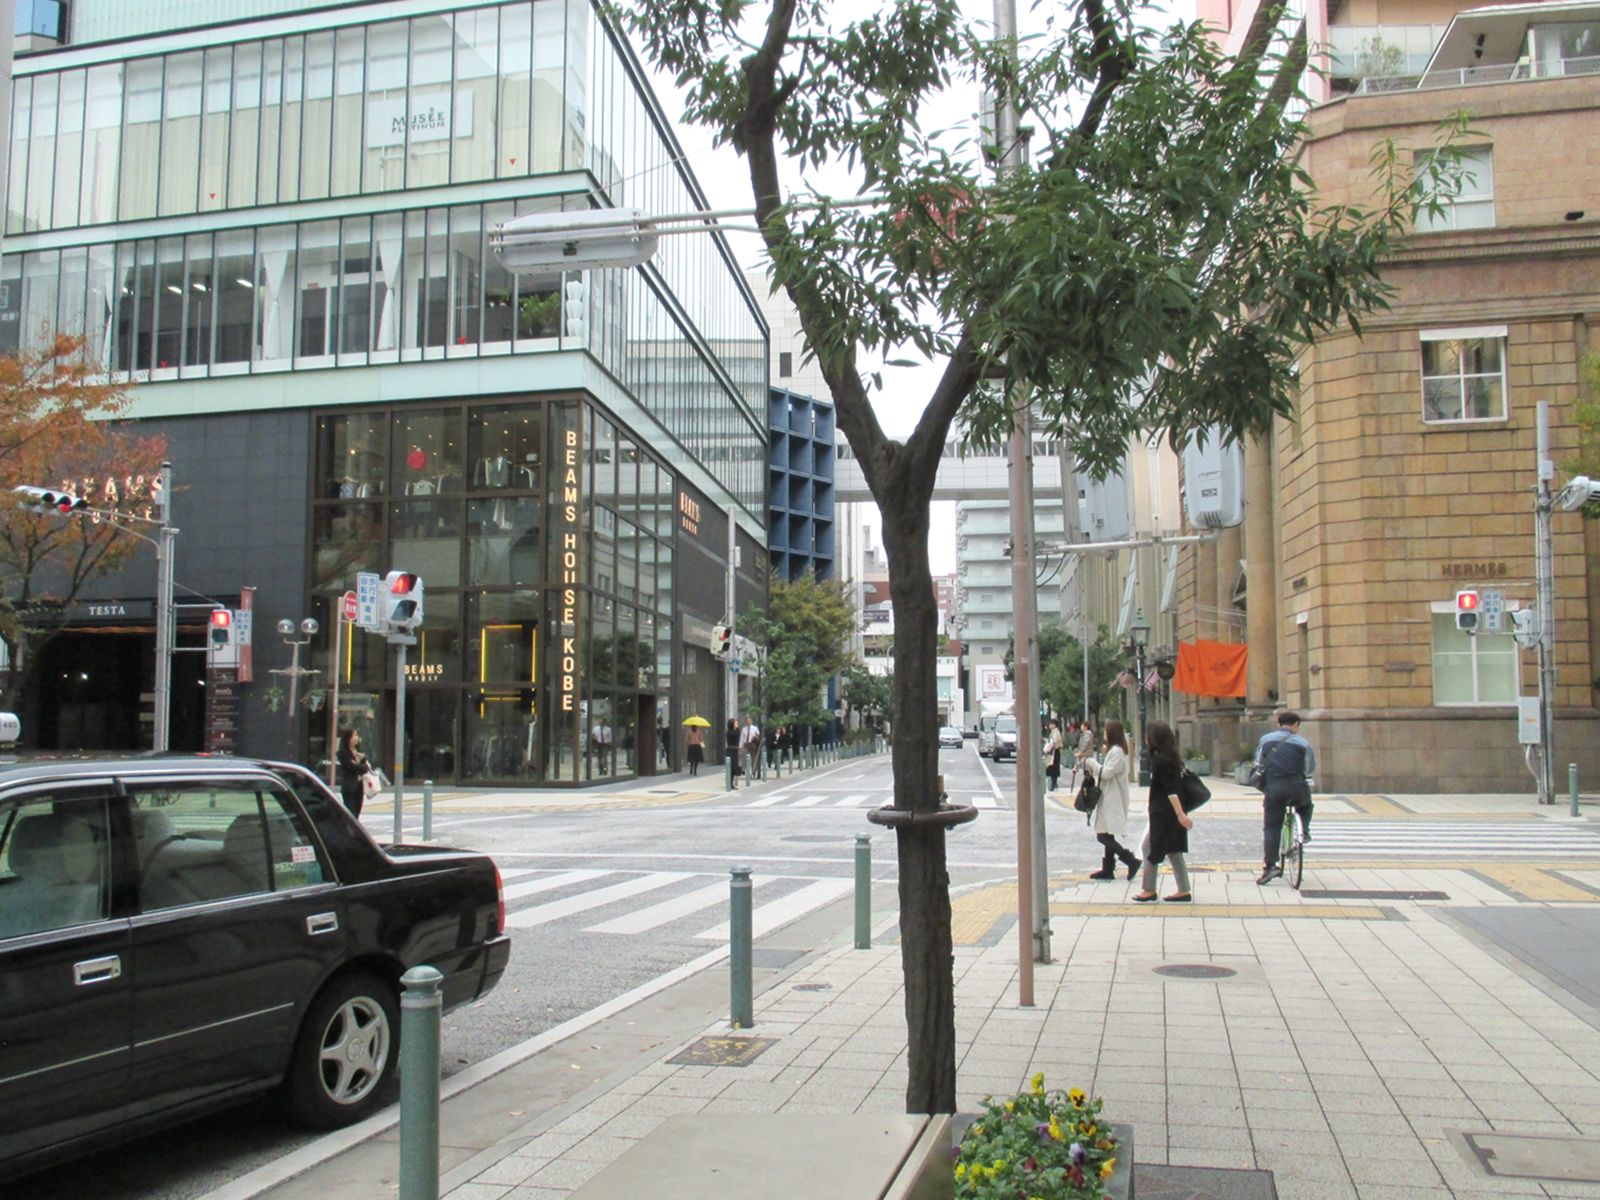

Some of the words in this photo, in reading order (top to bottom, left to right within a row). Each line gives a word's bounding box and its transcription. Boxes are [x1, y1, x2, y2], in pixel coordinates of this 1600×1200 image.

[391, 121, 445, 133] PLTINUM
[565, 430, 577, 521] BEAMS
[564, 533, 576, 624] HOUSE
[89, 605, 125, 616] TESTA
[403, 664, 444, 675] BEAMS
[563, 638, 574, 710] KOBE
